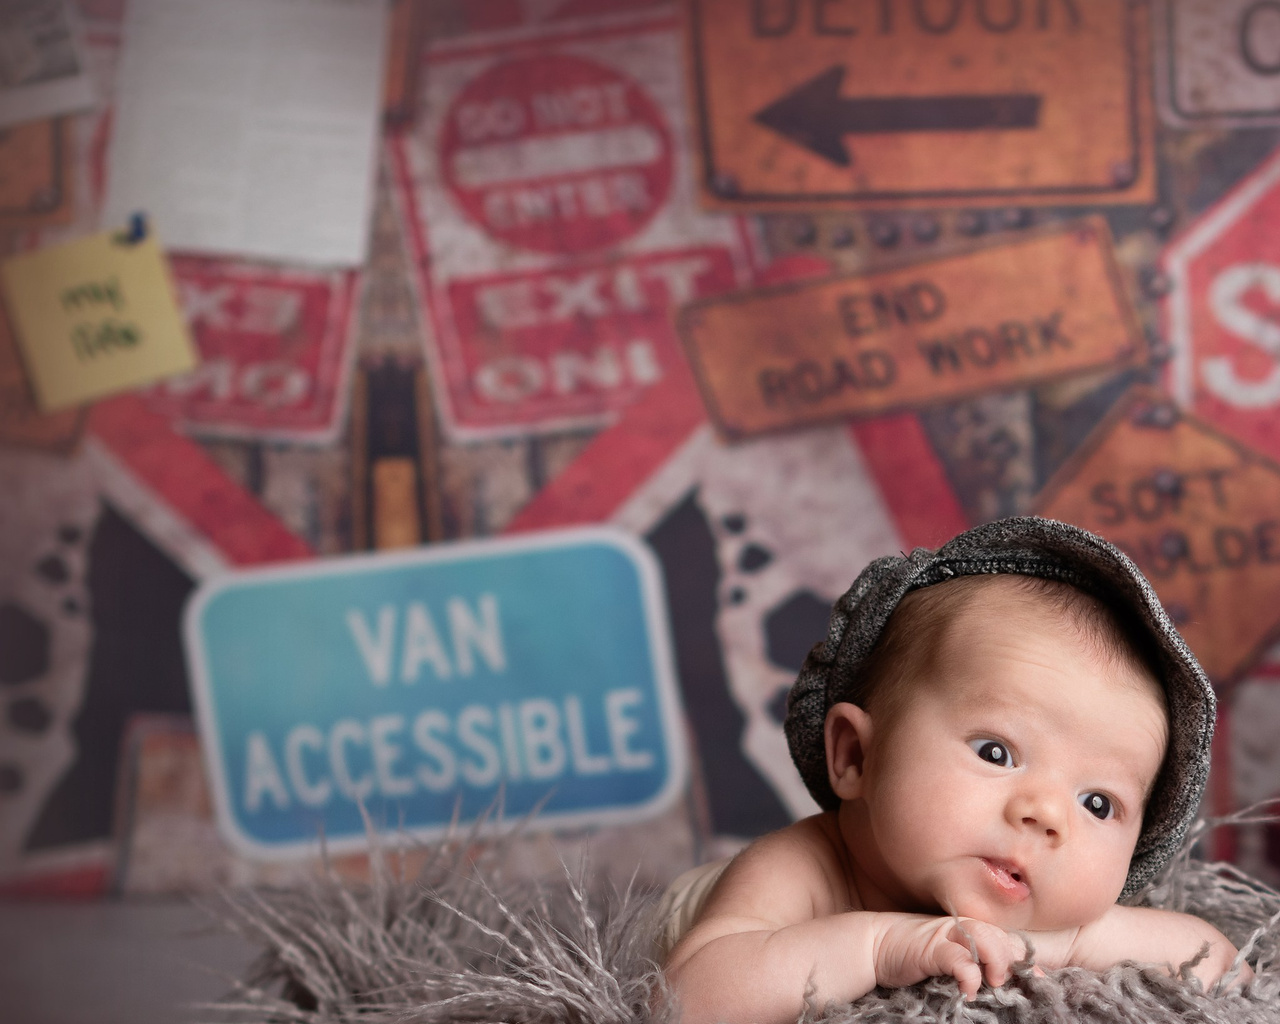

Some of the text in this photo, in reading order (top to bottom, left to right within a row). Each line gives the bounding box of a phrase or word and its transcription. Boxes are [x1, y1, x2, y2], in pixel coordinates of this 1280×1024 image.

[475, 258, 710, 330] EXIT
[837, 280, 947, 339] END
[757, 309, 1075, 407] ROAD WORK
[346, 594, 506, 688] VAN
[242, 687, 654, 813] ACCESSIBLE
